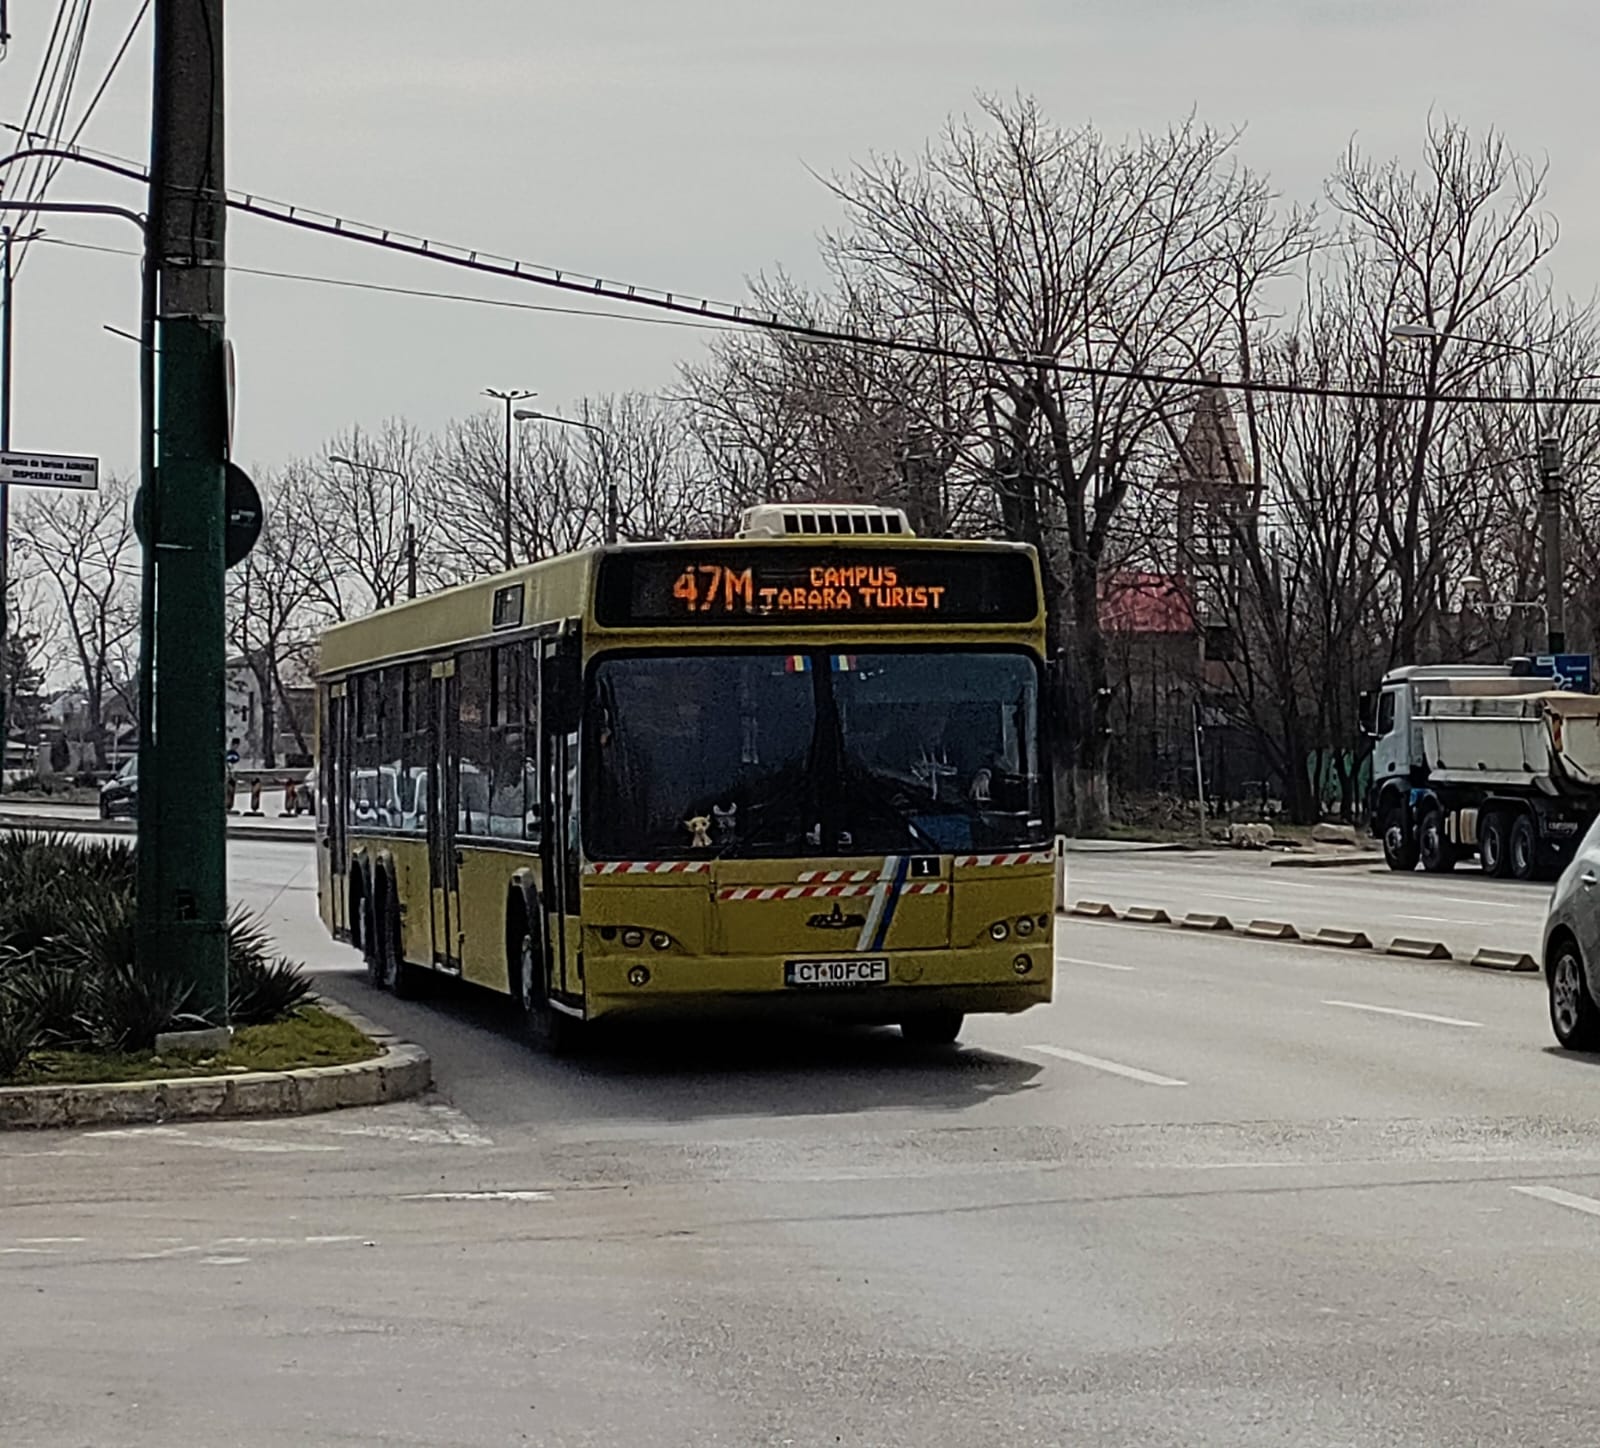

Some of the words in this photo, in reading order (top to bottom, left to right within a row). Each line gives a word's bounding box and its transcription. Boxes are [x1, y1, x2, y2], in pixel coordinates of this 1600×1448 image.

[809, 566, 897, 587] CAMPUS
[673, 565, 753, 611] 47M
[759, 587, 850, 609] TABARA
[858, 586, 945, 608] TURIST
[922, 860, 930, 874] 1
